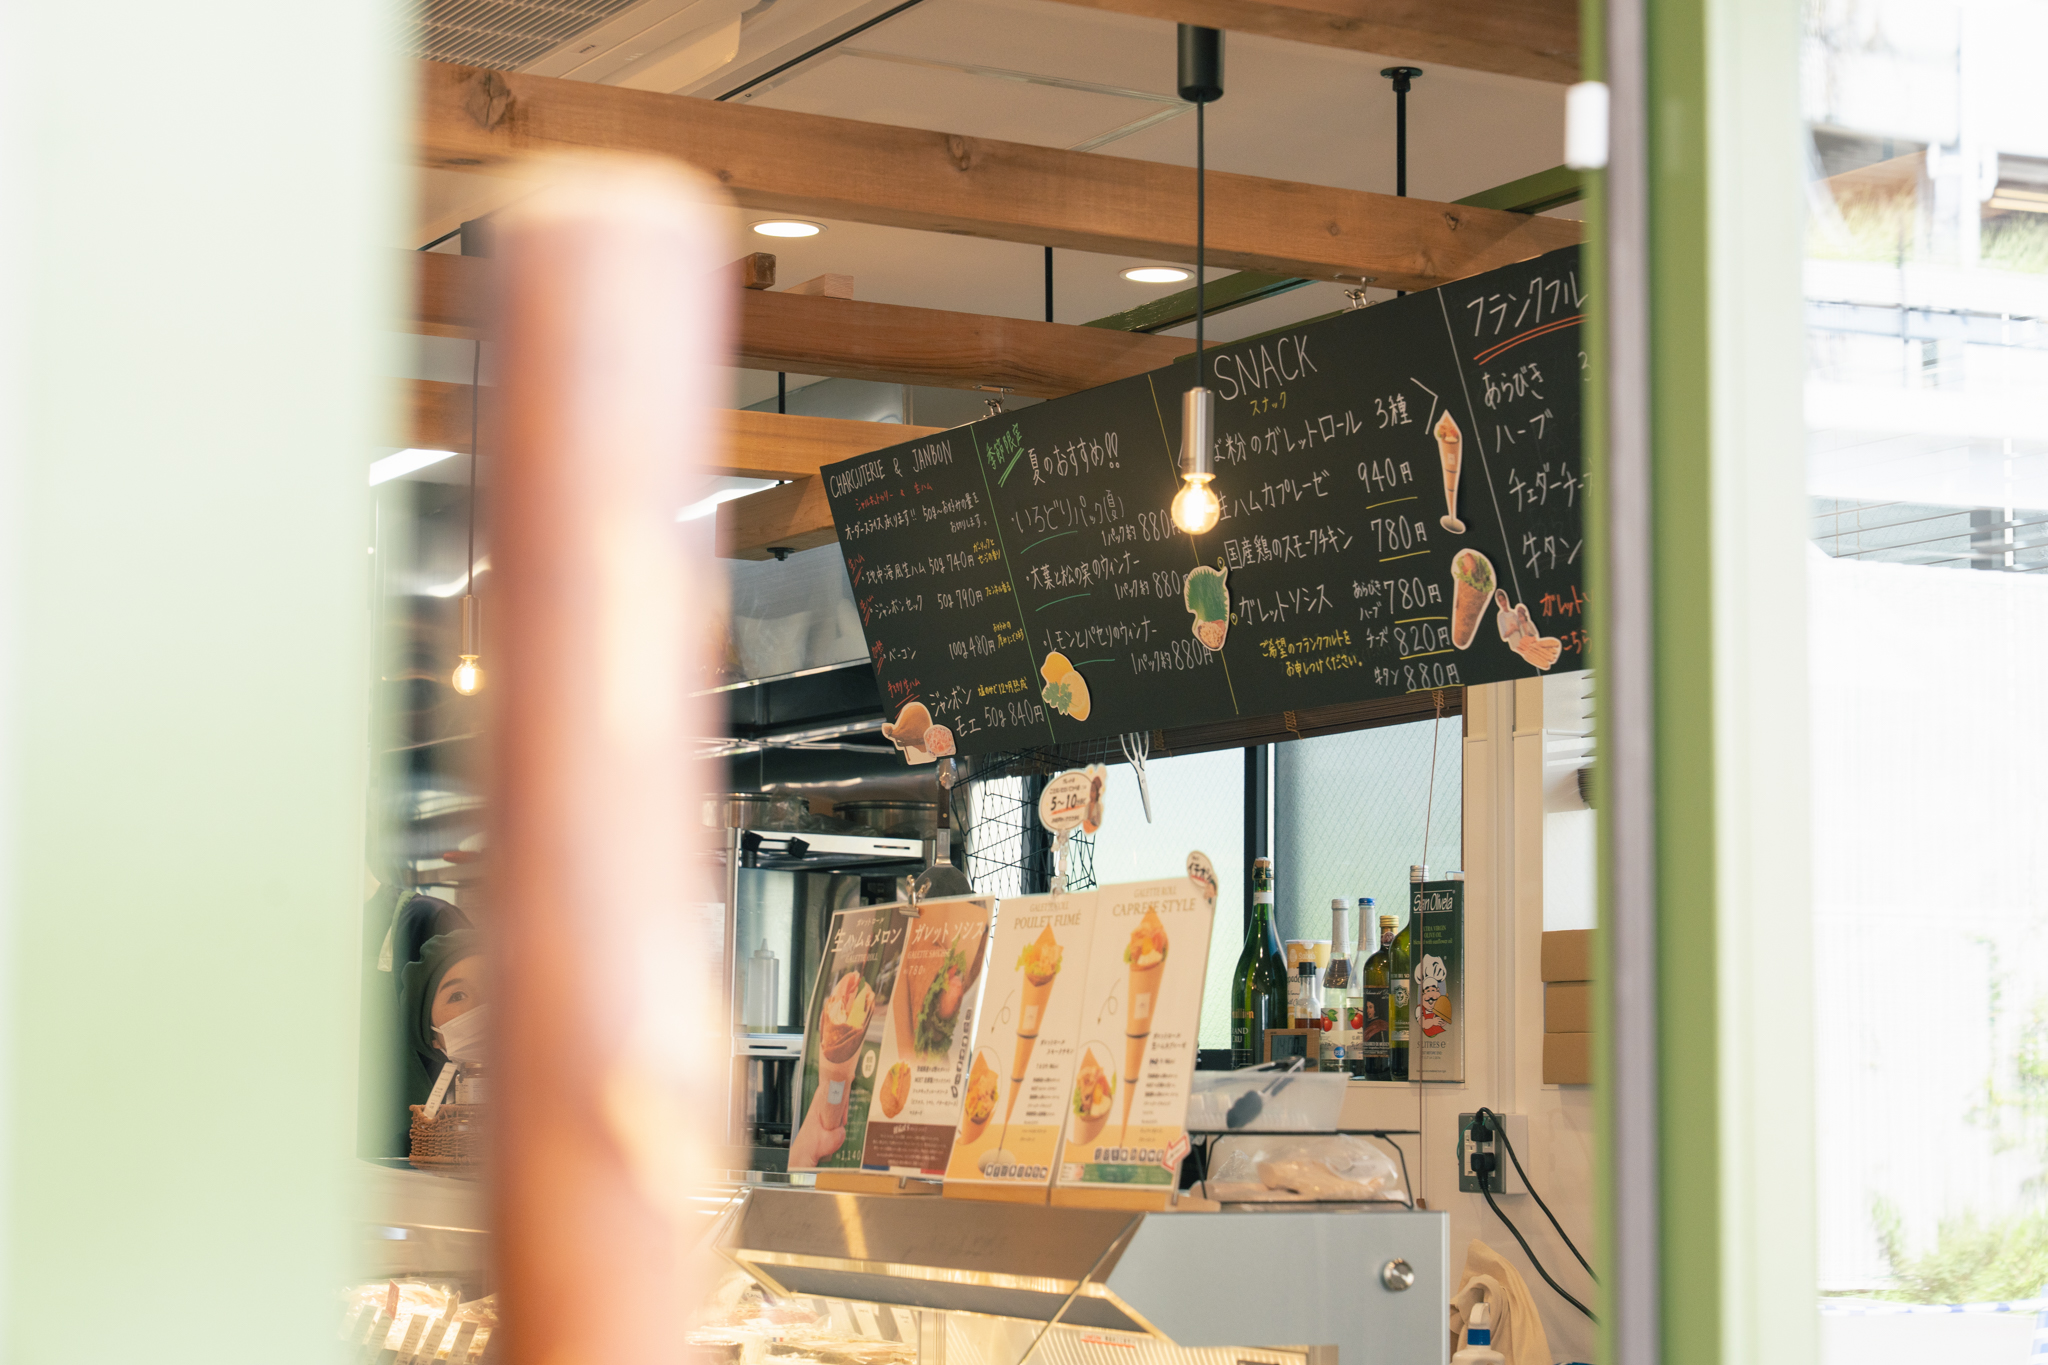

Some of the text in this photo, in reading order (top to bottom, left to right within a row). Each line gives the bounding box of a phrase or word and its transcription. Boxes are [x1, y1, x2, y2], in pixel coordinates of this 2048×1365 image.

[1467, 271, 1588, 336] フランクフル
[1214, 335, 1318, 400] SNACK
[1250, 391, 1287, 416] スナック
[1482, 363, 1544, 410] あらびき
[1374, 393, 1413, 429] 3種
[986, 422, 1022, 471] 季節限定
[1496, 408, 1553, 453] ハーブ
[829, 440, 953, 498] CHARCUTERIE & JANBON
[1217, 457, 1413, 521] 生ハムカプレーゼ 940円
[946, 551, 975, 572] 740円
[1224, 515, 1427, 571] 国産鶏のスモークチキン 780円
[1523, 532, 1583, 579] 牛タン
[1030, 550, 1140, 590] 大葉と松の実のウィンナー
[955, 588, 983, 609] 790円
[1239, 584, 1333, 625] ガレットソシス
[1352, 577, 1442, 614] あらびき 780円
[1360, 601, 1382, 621] ハーブ
[889, 647, 916, 662] ベーコン
[969, 635, 996, 657] 480円
[1046, 615, 1157, 652] レモンとパセリのウィンナー
[1259, 629, 1352, 659] ご希望のフランクフルトを
[1366, 623, 1450, 656] チーズ 820円
[1374, 662, 1460, 691] 牛タン 880円
[929, 685, 972, 717] ジャンボン
[955, 699, 1044, 737] モエ 50g 840円
[1161, 898, 1197, 913] STYLE
[1430, 892, 1453, 911] Olivela
[1014, 914, 1053, 930] POULET
